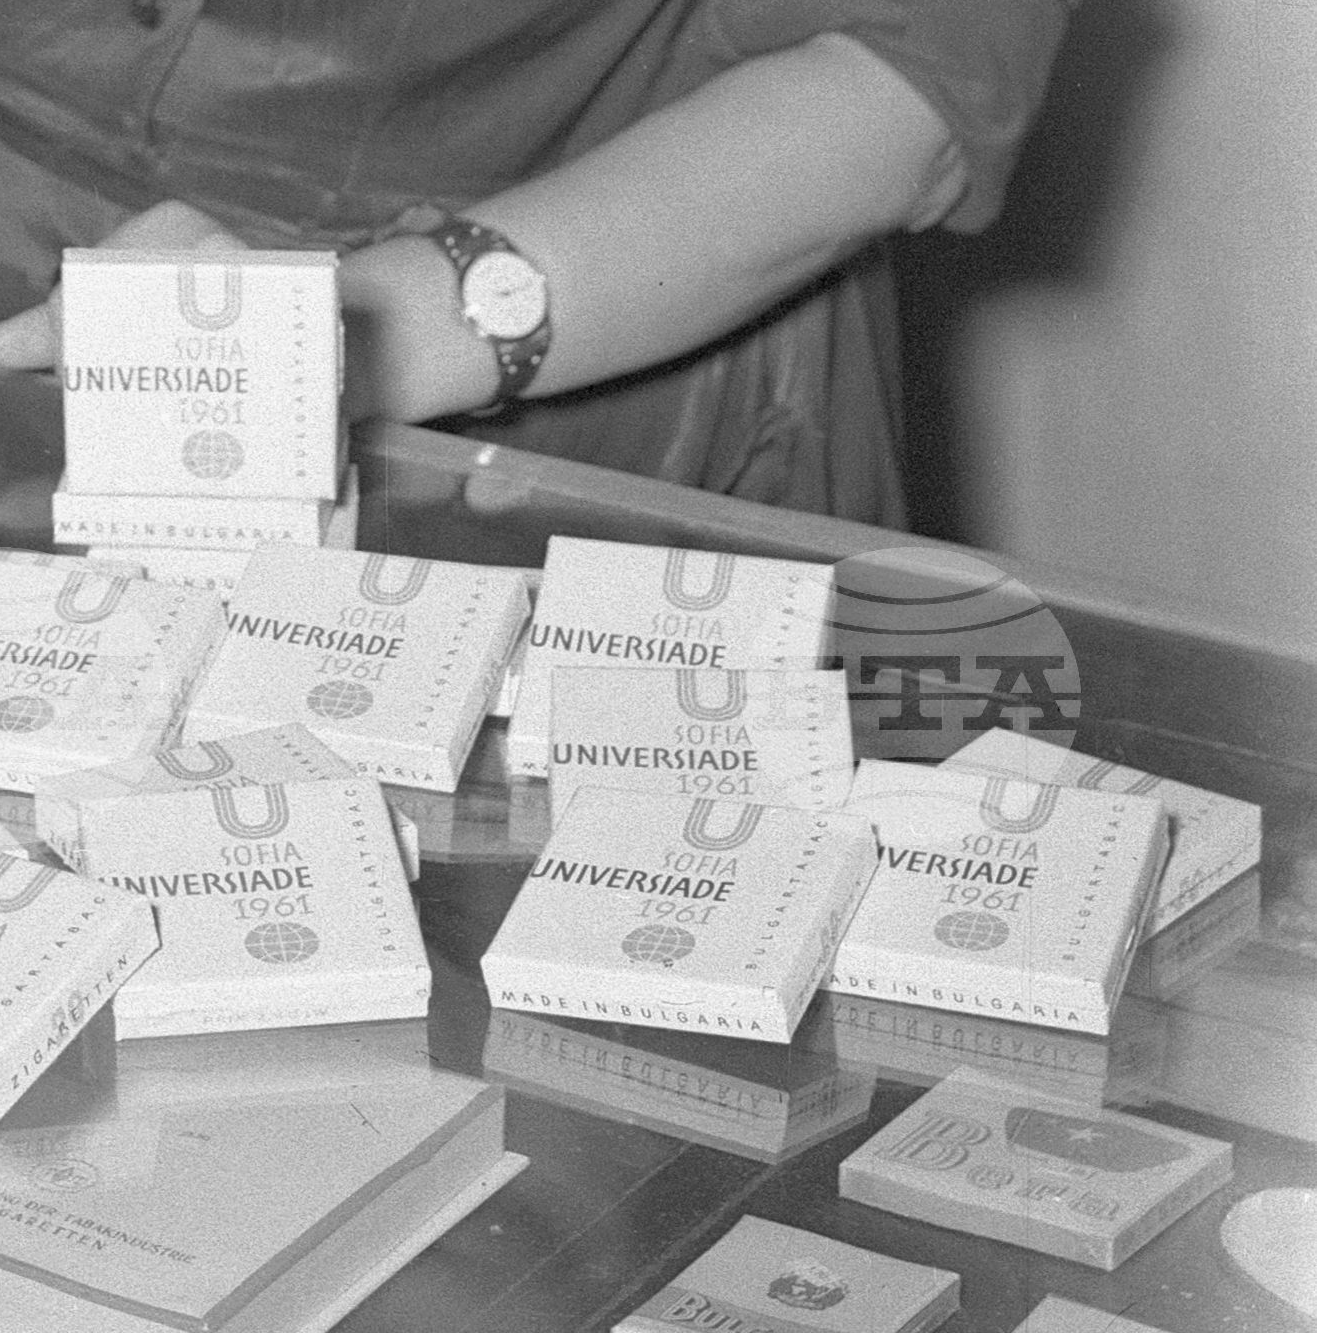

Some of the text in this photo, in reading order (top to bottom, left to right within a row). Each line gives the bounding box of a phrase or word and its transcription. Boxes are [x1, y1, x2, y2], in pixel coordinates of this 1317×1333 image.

[172, 336, 247, 362] SOFIA
[64, 366, 249, 393] UNIVERSIADE
[180, 399, 247, 424] 1961
[359, 552, 432, 606] U
[662, 548, 735, 611] U
[54, 570, 133, 624] U
[336, 607, 407, 633] SOFIA
[651, 612, 725, 638] SOFIA
[33, 623, 104, 650] SOFIA
[529, 624, 727, 670] UNIVERSIADE
[4, 668, 78, 698] 1961
[316, 654, 387, 683] 1961
[675, 669, 747, 722] U
[672, 724, 753, 747] SOFIA
[553, 742, 759, 772] UNIVERSIADE
[356, 762, 435, 783] GARIA
[675, 773, 755, 797] 1961
[211, 783, 290, 840] U
[979, 775, 1062, 833] U
[682, 798, 764, 852] U
[219, 840, 304, 867] SOFIA
[961, 835, 1040, 863] SOFIA
[662, 851, 739, 878] SOFIA
[529, 858, 735, 903] UNIVERSIADE
[233, 893, 314, 921] 1961
[634, 899, 717, 926] 1961
[940, 882, 1024, 914] 1961
[501, 990, 762, 1033] MADE IN BULGARIA
[825, 974, 1080, 1021] ADE IN BULGARIA
